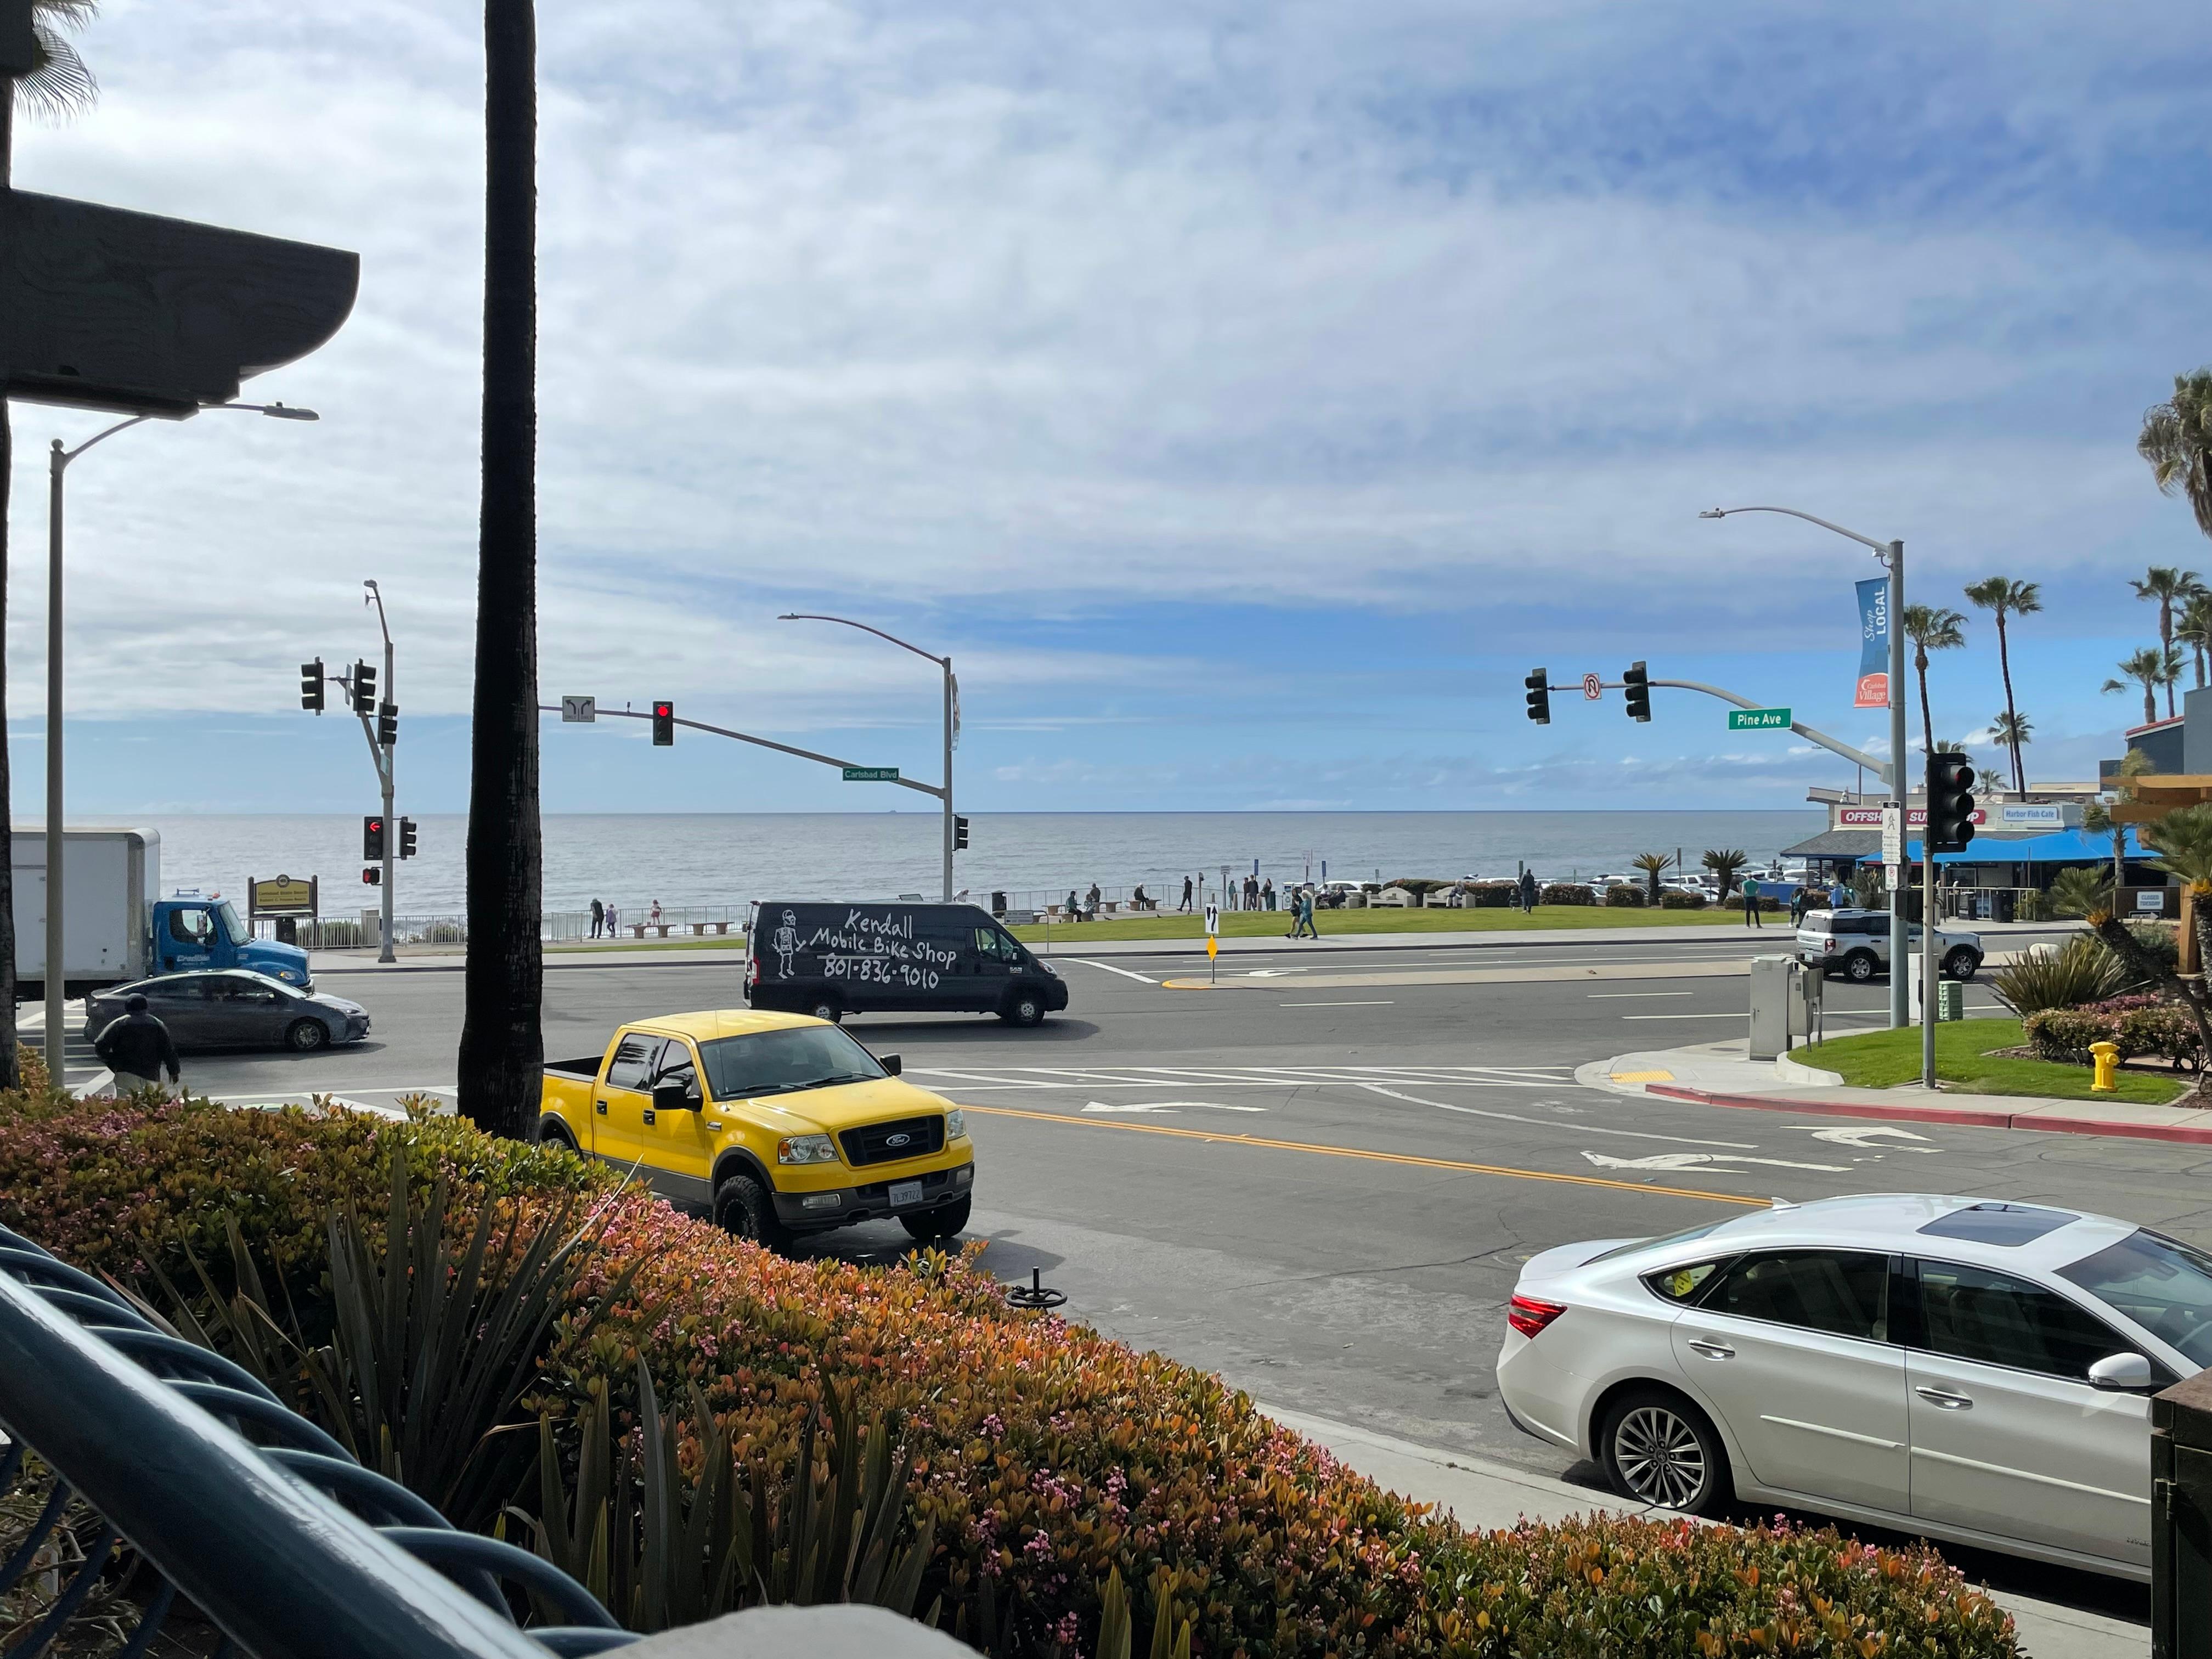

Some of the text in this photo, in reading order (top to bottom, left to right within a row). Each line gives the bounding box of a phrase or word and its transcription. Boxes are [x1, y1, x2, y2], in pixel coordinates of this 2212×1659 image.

[1864, 610, 1876, 641] Shop
[1875, 586, 1886, 635] LOCAL
[1859, 690, 1886, 702] Village
[1737, 713, 1781, 725] Pine Ave
[1846, 812, 1882, 821] OFFSH
[844, 909, 912, 939] Kendall
[810, 928, 866, 950] Mobile
[912, 942, 956, 970] Shop
